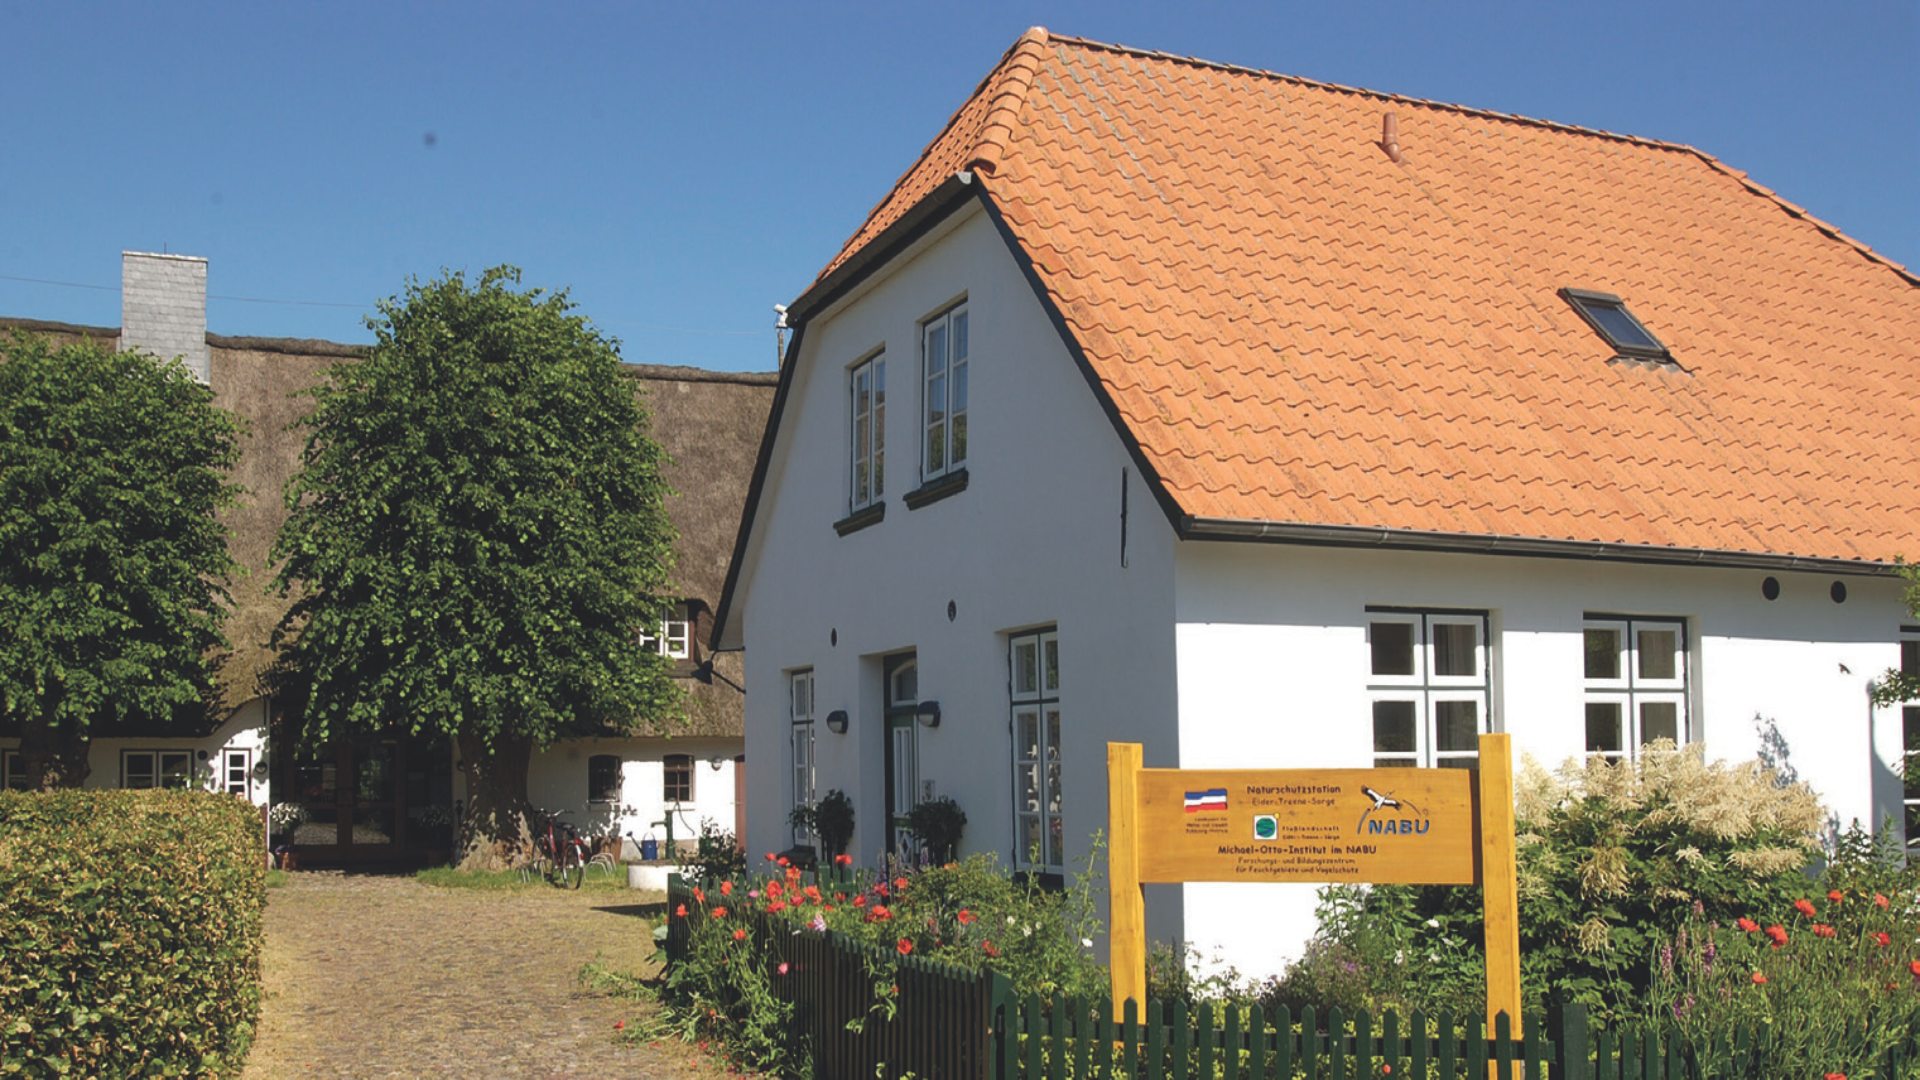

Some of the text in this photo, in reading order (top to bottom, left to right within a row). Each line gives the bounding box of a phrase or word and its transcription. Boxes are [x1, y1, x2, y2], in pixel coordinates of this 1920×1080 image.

[1368, 818, 1430, 835] NABU
[1331, 845, 1342, 854] im
[1346, 845, 1377, 854] NABU
